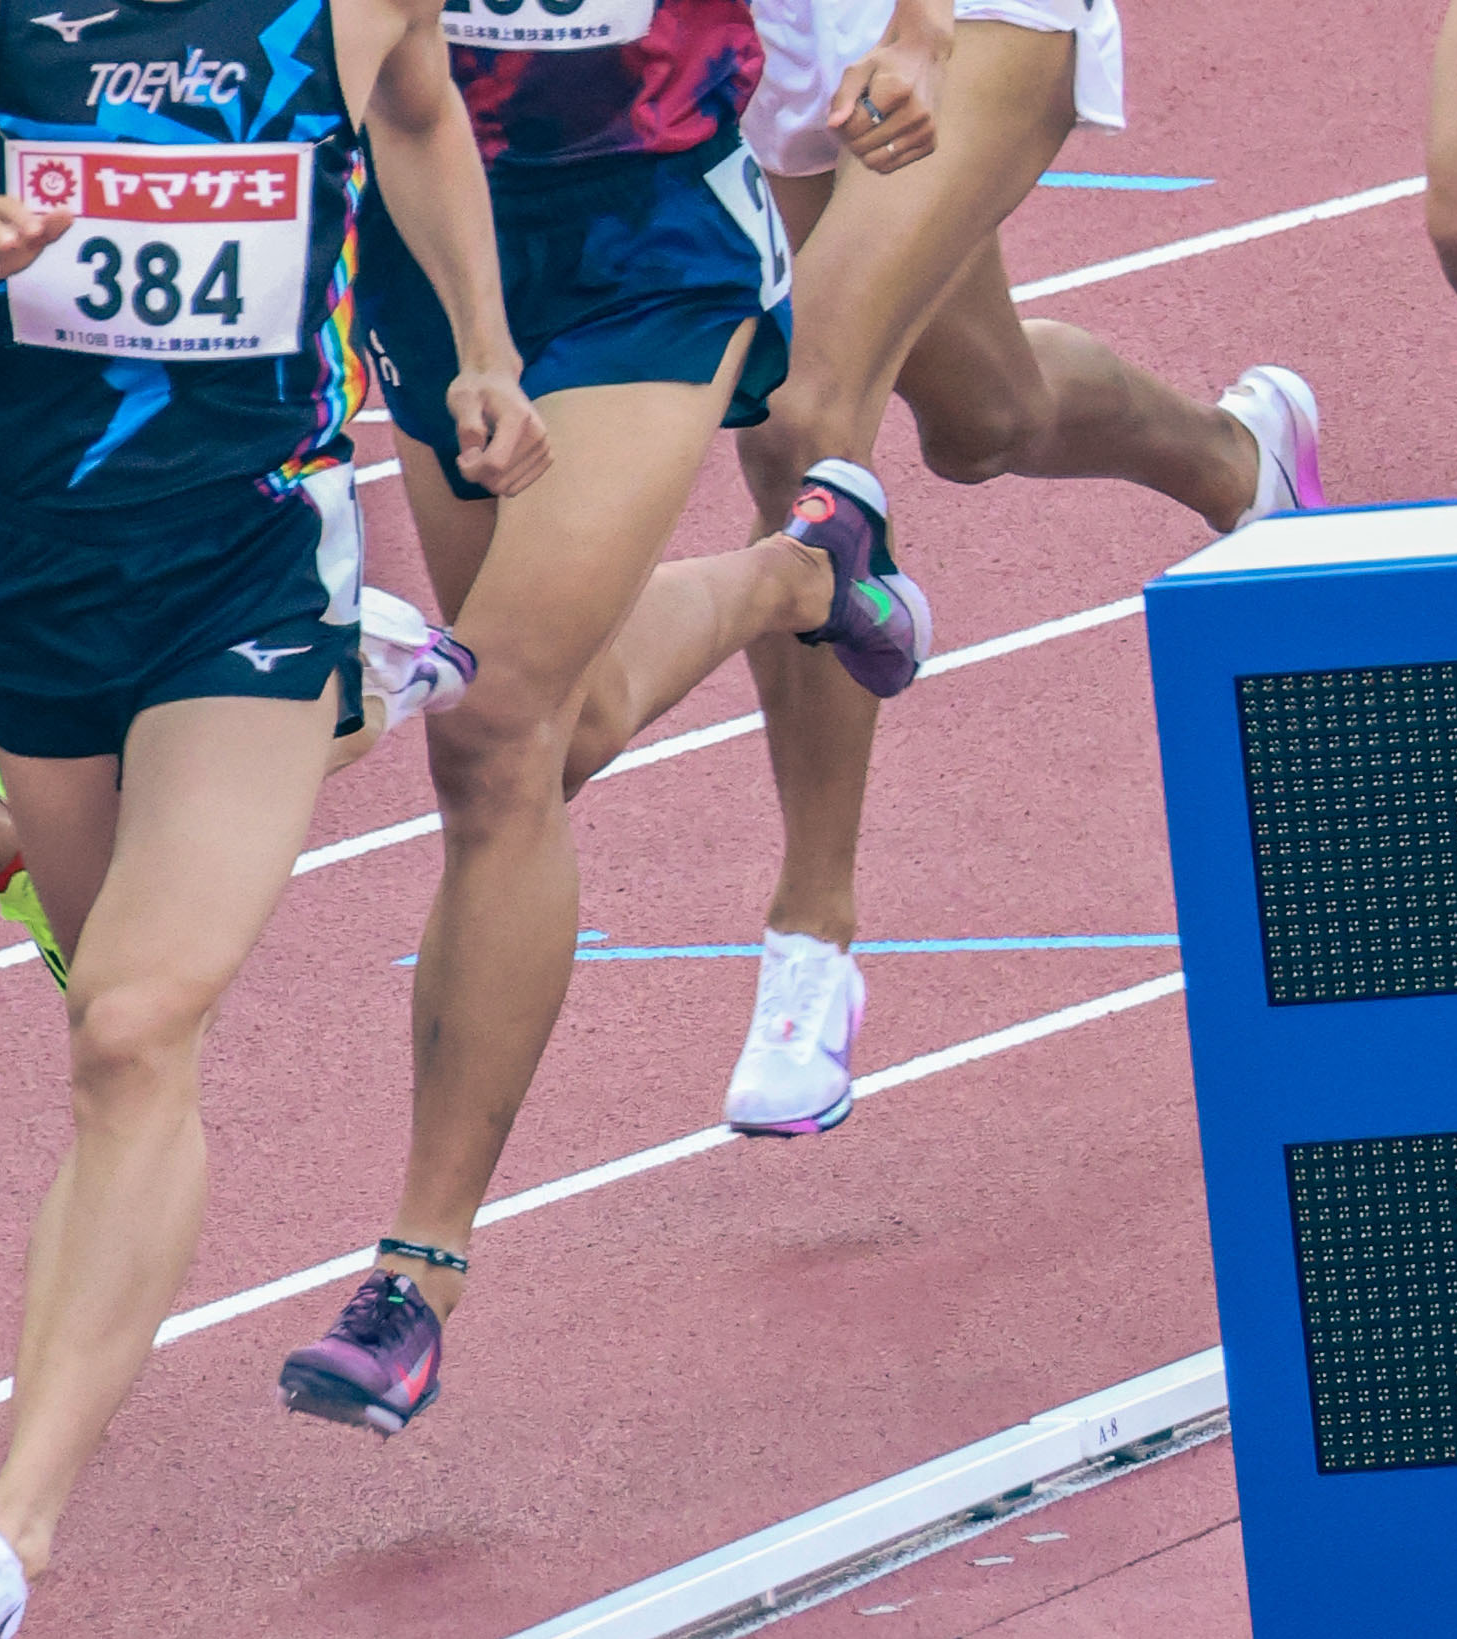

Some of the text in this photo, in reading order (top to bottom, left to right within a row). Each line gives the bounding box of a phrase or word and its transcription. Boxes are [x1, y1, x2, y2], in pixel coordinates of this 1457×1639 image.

[85, 48, 247, 115] TOENEC
[94, 168, 286, 211] ヤマザキ
[74, 235, 244, 327] 384
[54, 327, 262, 352] 第110回 日本陸上競技選手権大会
[1098, 1416, 1118, 1446] A-8
